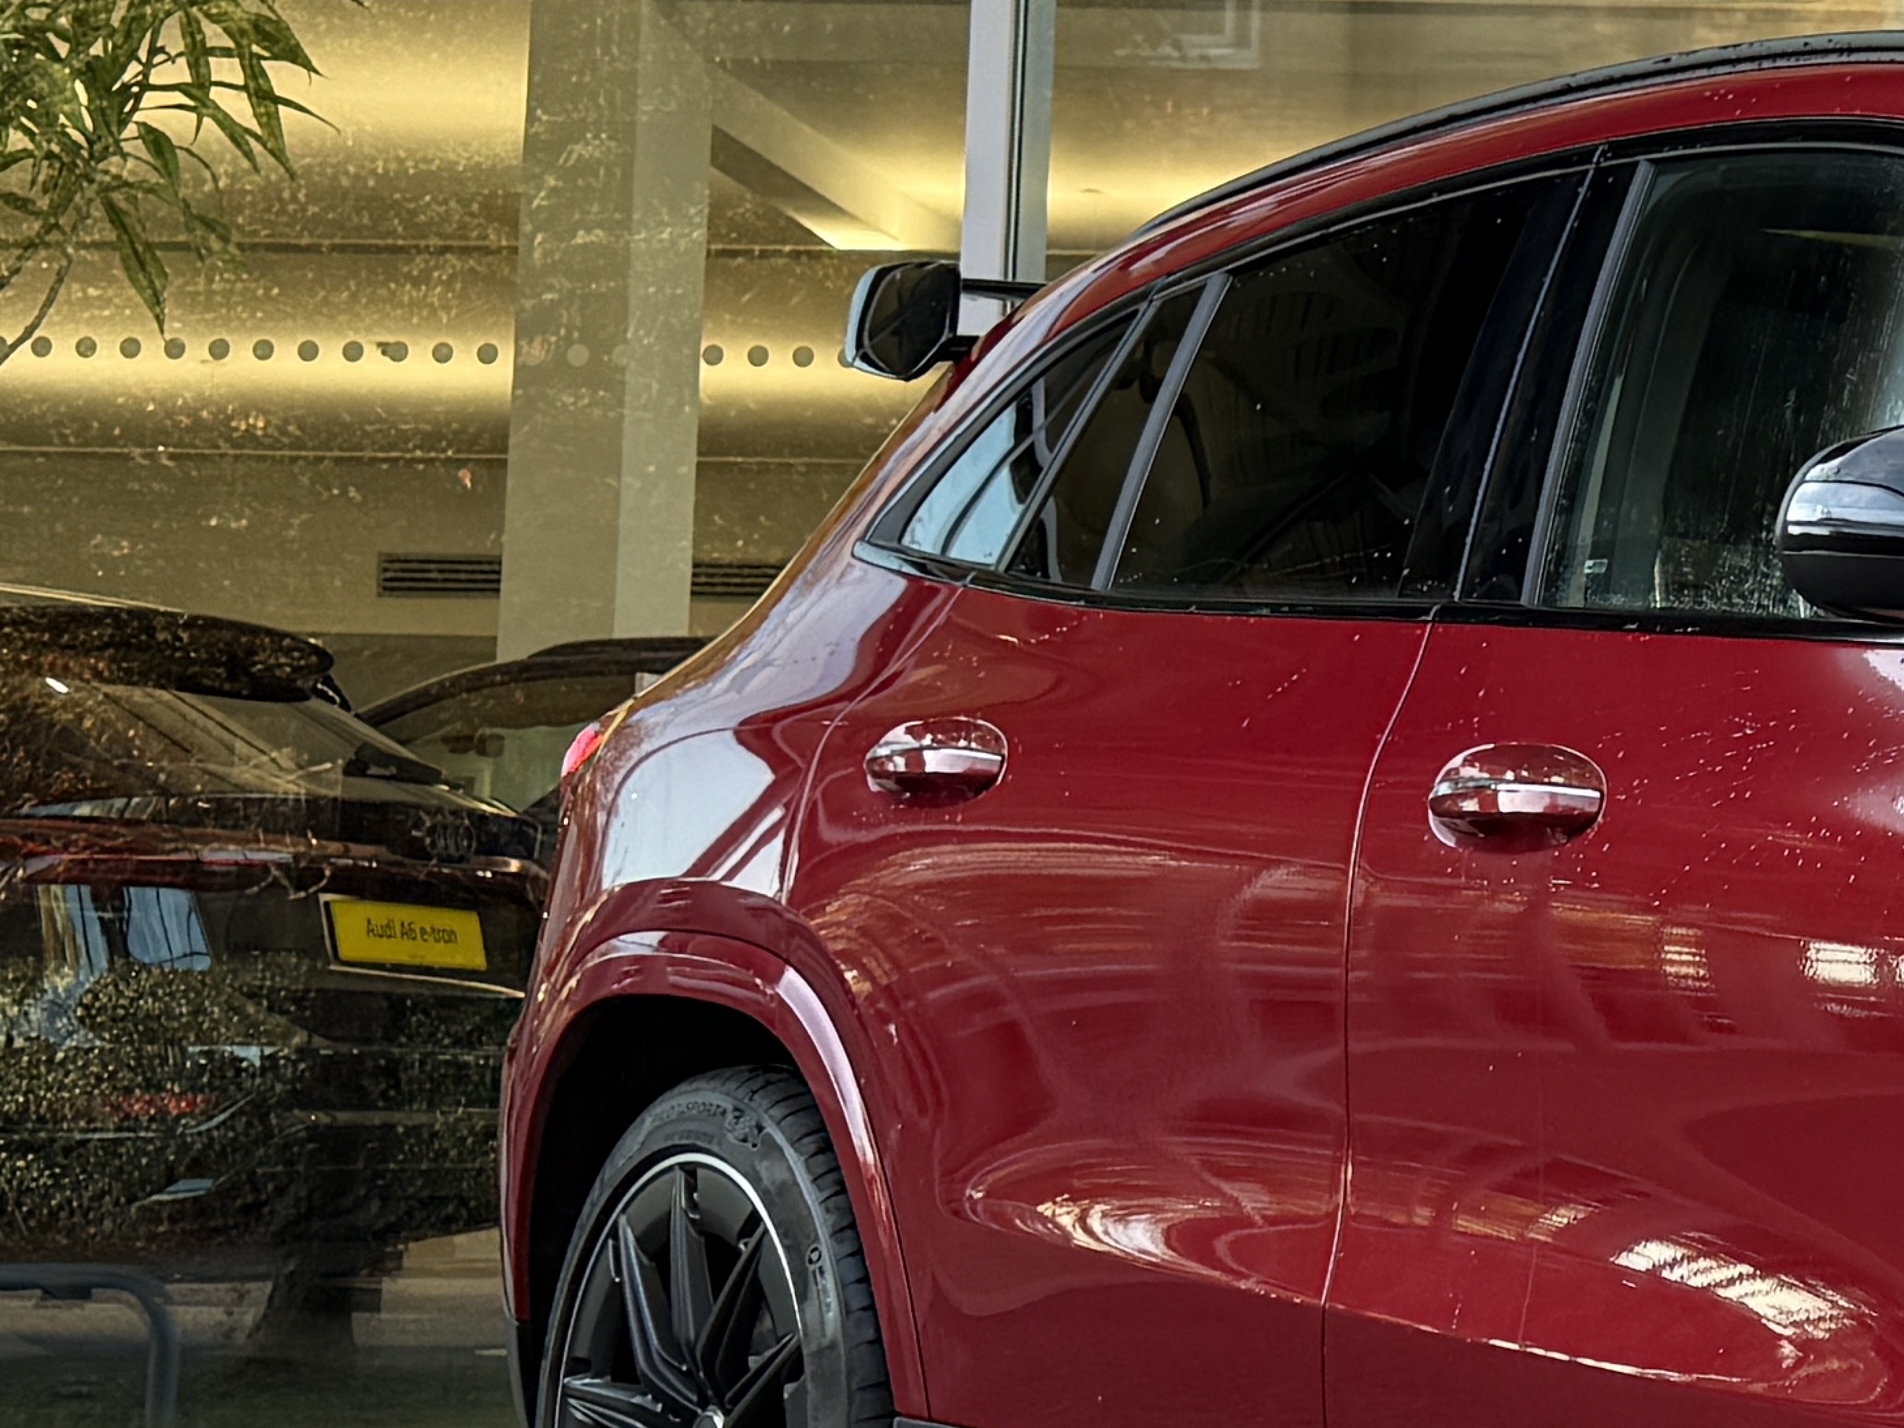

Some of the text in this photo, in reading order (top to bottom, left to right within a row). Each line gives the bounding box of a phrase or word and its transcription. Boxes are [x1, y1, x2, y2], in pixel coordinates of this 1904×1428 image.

[366, 917, 458, 945] Audi A6 e-tron
